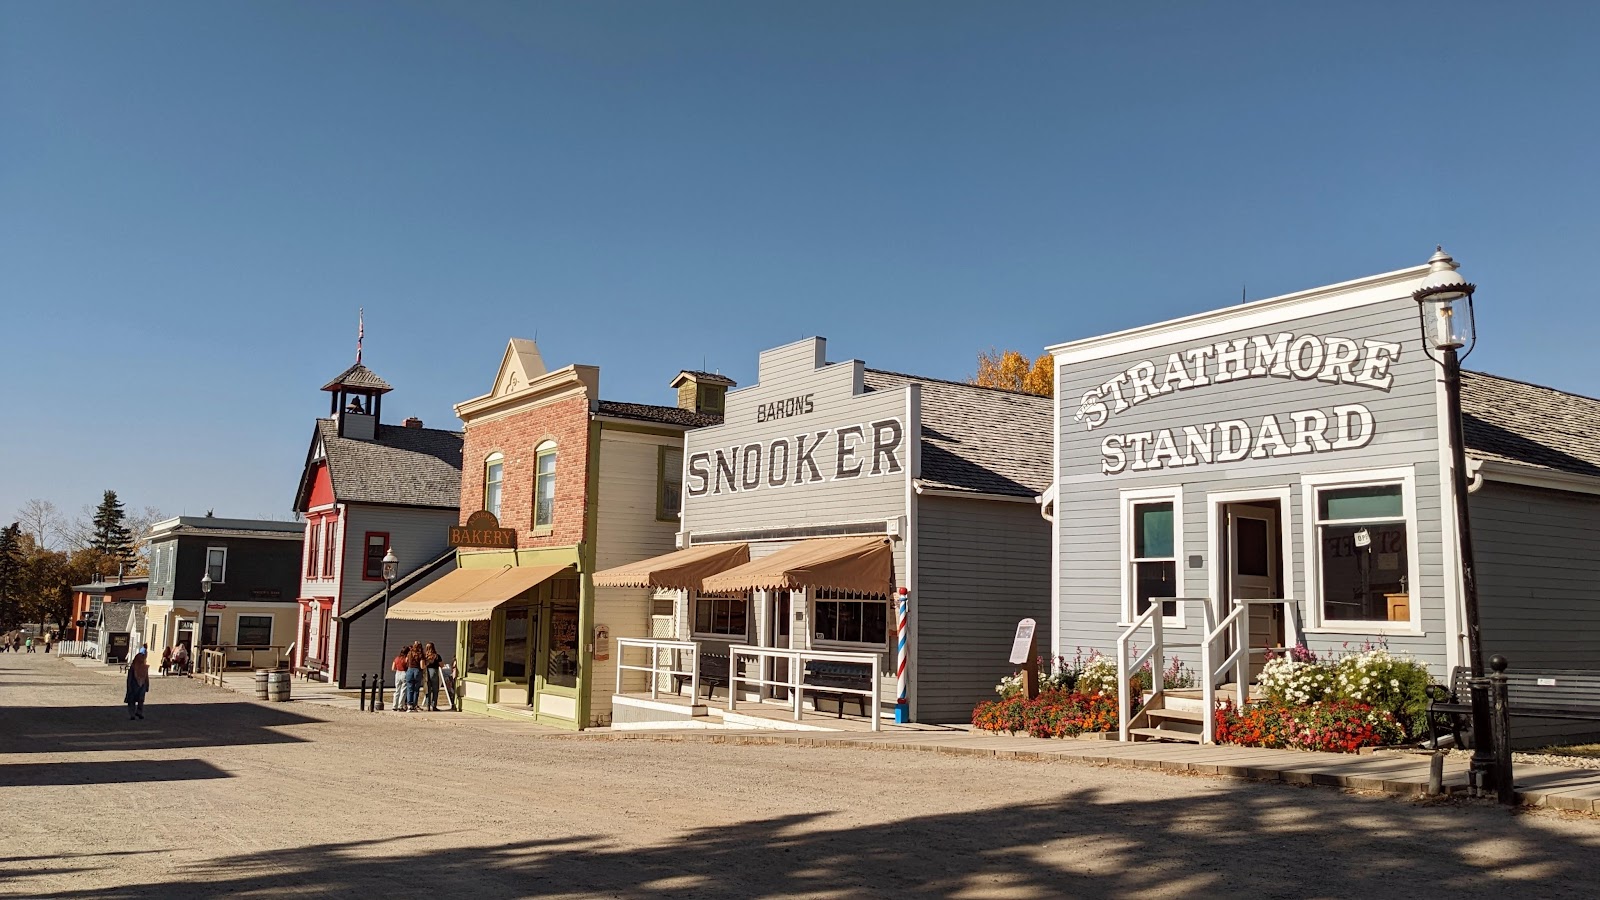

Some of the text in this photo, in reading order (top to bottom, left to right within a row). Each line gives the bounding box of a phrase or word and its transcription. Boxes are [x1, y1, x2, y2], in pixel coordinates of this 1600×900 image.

[1080, 332, 1402, 430] STRATHMORE
[757, 393, 814, 423] BARONS
[687, 417, 904, 498] SNOOKER
[1101, 402, 1376, 476] STANDARD
[452, 528, 513, 545] BAKERY
[469, 512, 497, 527] ALBERTA
